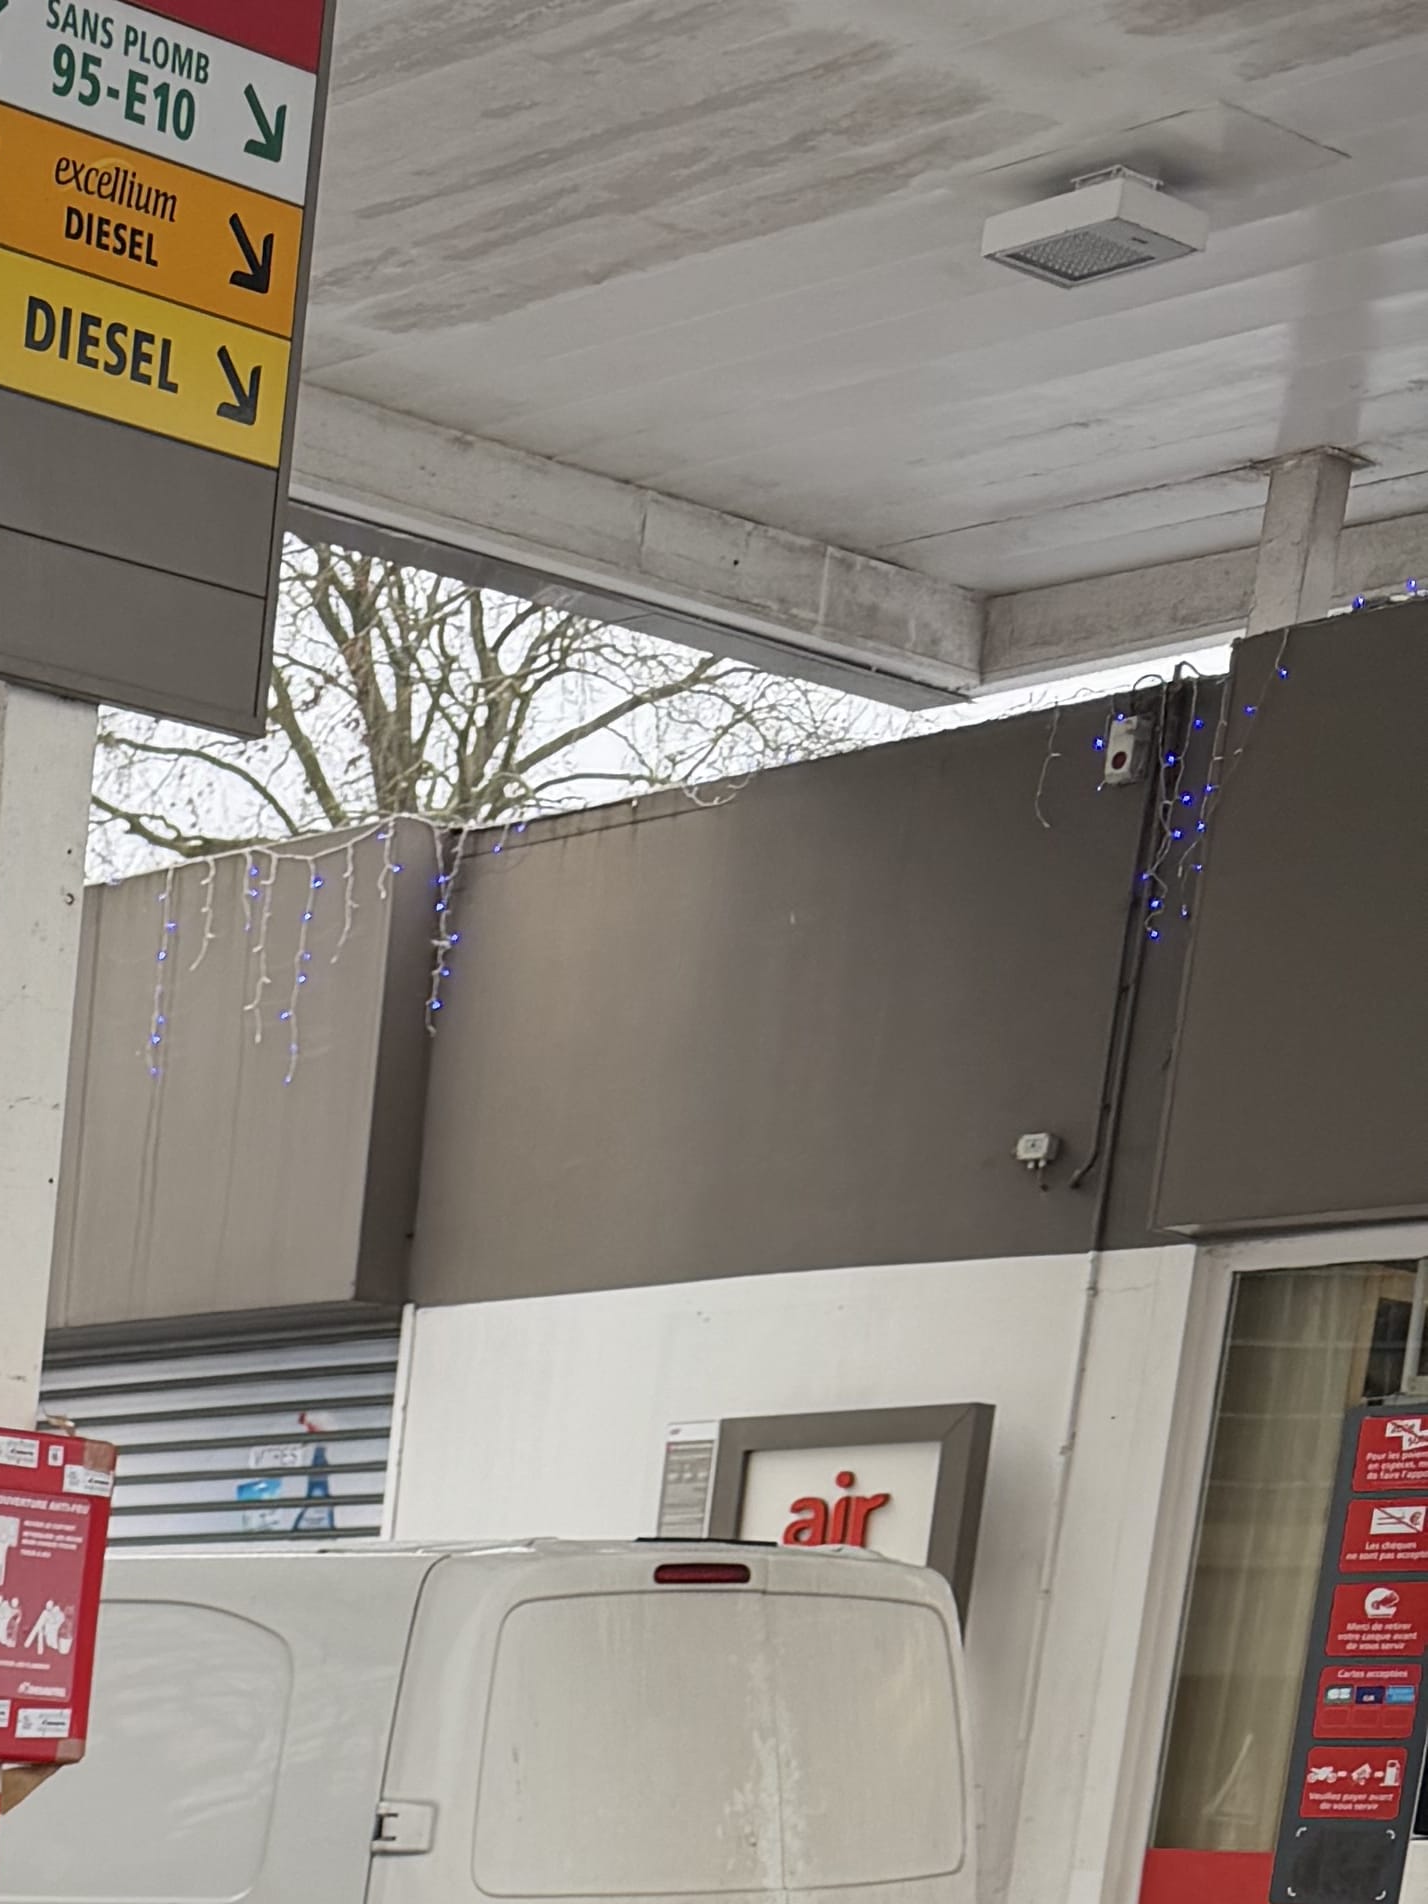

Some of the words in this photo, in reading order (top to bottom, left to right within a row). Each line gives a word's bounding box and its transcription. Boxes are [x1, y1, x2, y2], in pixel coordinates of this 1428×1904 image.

[46, 0, 115, 50] SANS
[123, 24, 211, 85] PLOMB
[51, 43, 196, 142] 95-E10
[54, 156, 178, 223] excellium
[64, 205, 159, 268] DIESEL
[23, 295, 179, 394] DIESEL
[782, 1470, 892, 1549] air
